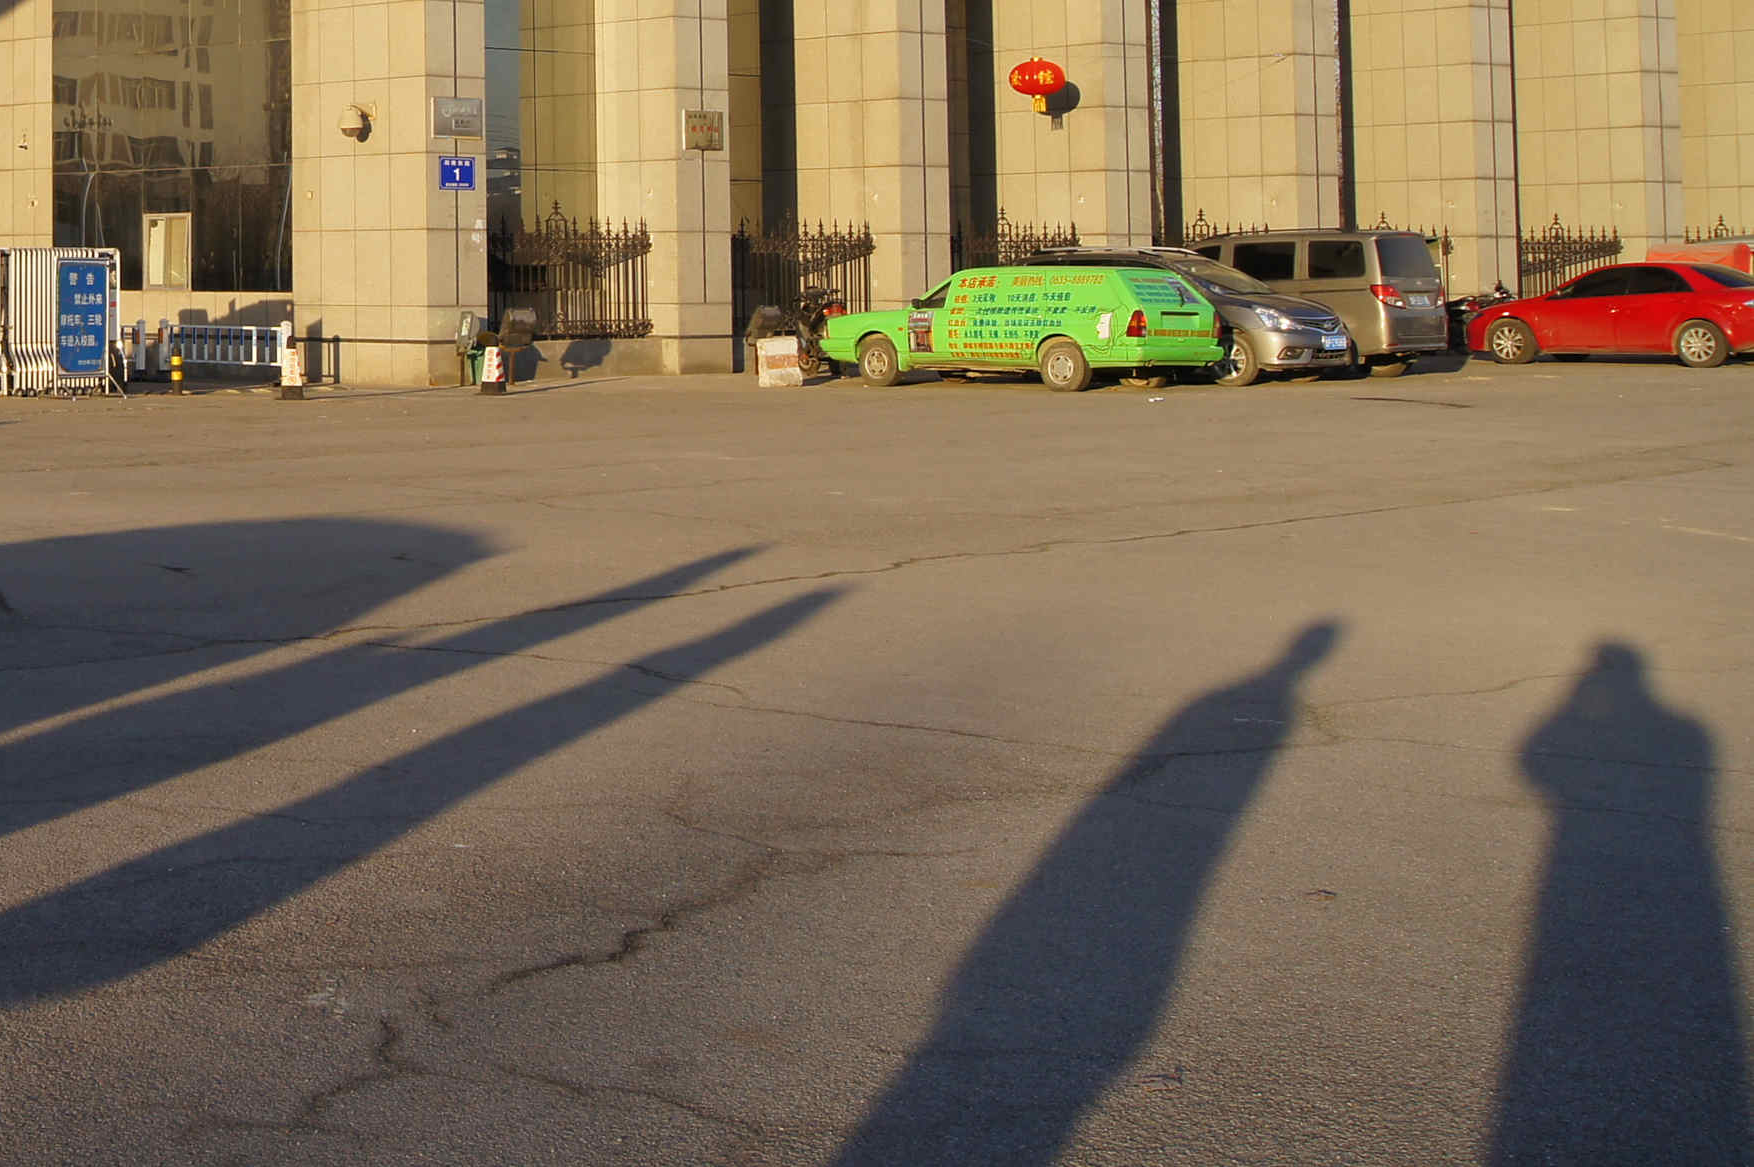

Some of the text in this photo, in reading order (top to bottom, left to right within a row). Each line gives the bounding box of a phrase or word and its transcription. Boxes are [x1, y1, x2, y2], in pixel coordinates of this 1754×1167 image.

[453, 167, 461, 182] 1
[73, 293, 103, 305] 禁止外来
